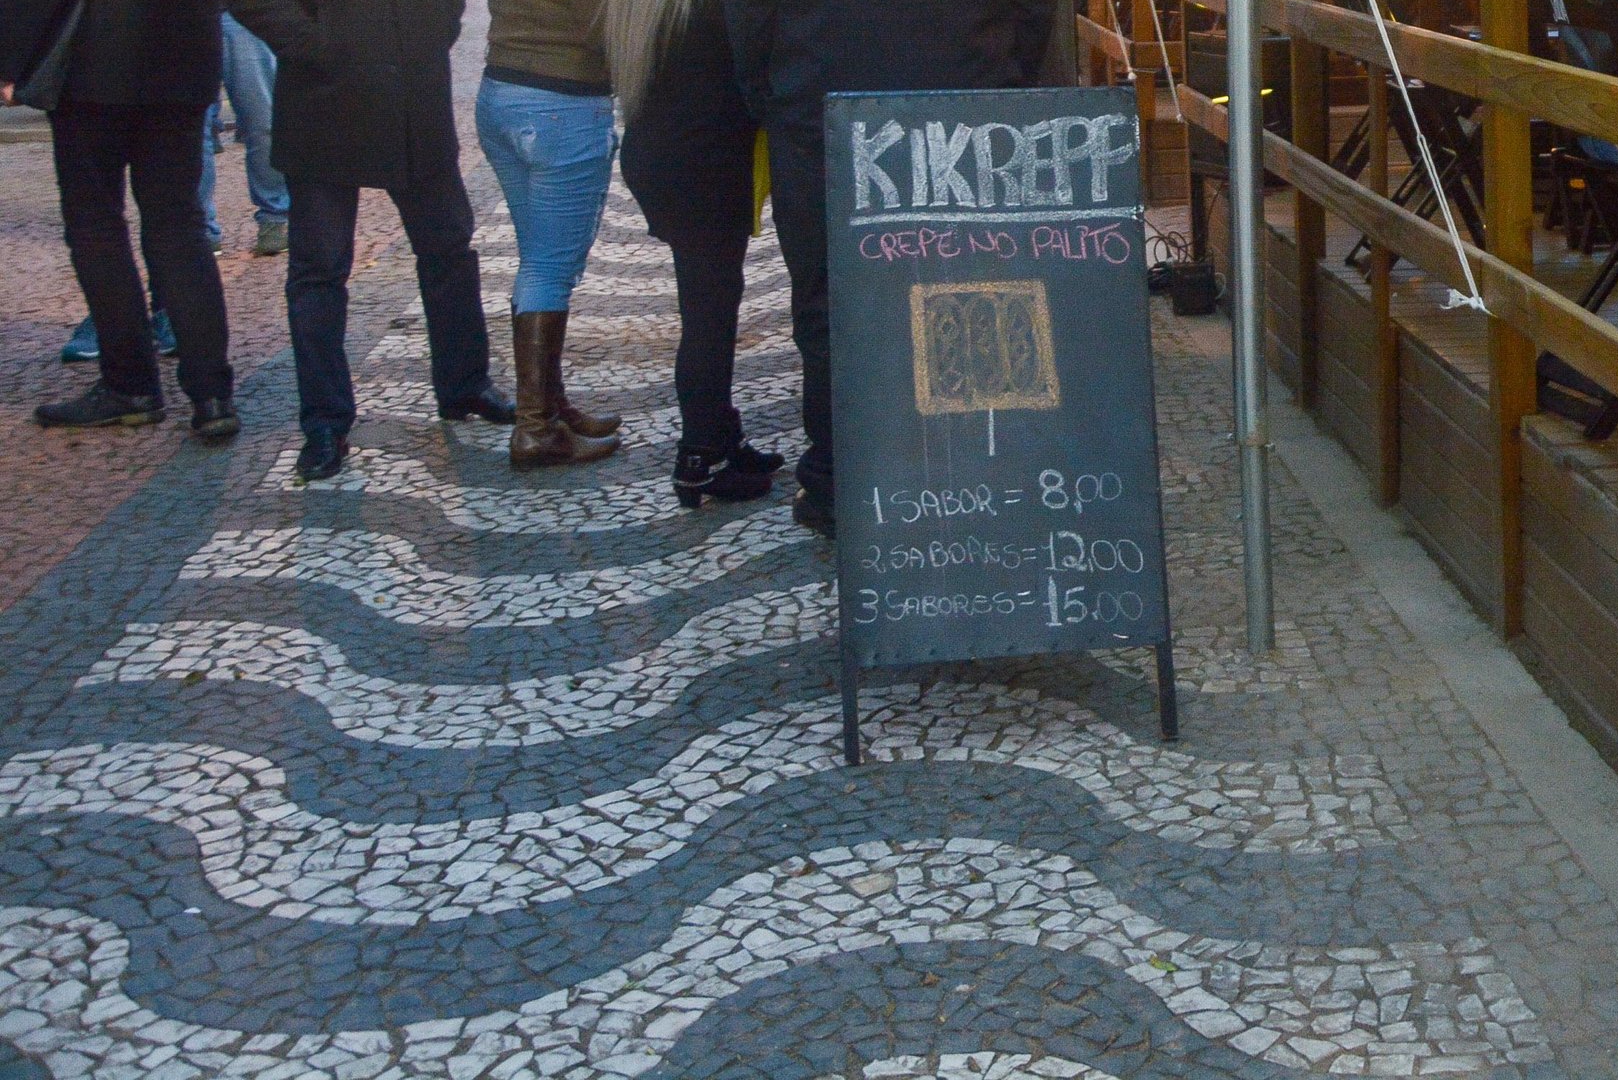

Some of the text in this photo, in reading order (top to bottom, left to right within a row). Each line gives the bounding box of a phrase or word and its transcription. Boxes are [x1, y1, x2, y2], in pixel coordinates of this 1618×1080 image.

[859, 223, 1130, 264] CREPE NO PALITO
[863, 487, 888, 524] 1
[891, 484, 997, 523] SABOR
[855, 589, 878, 623] 3
